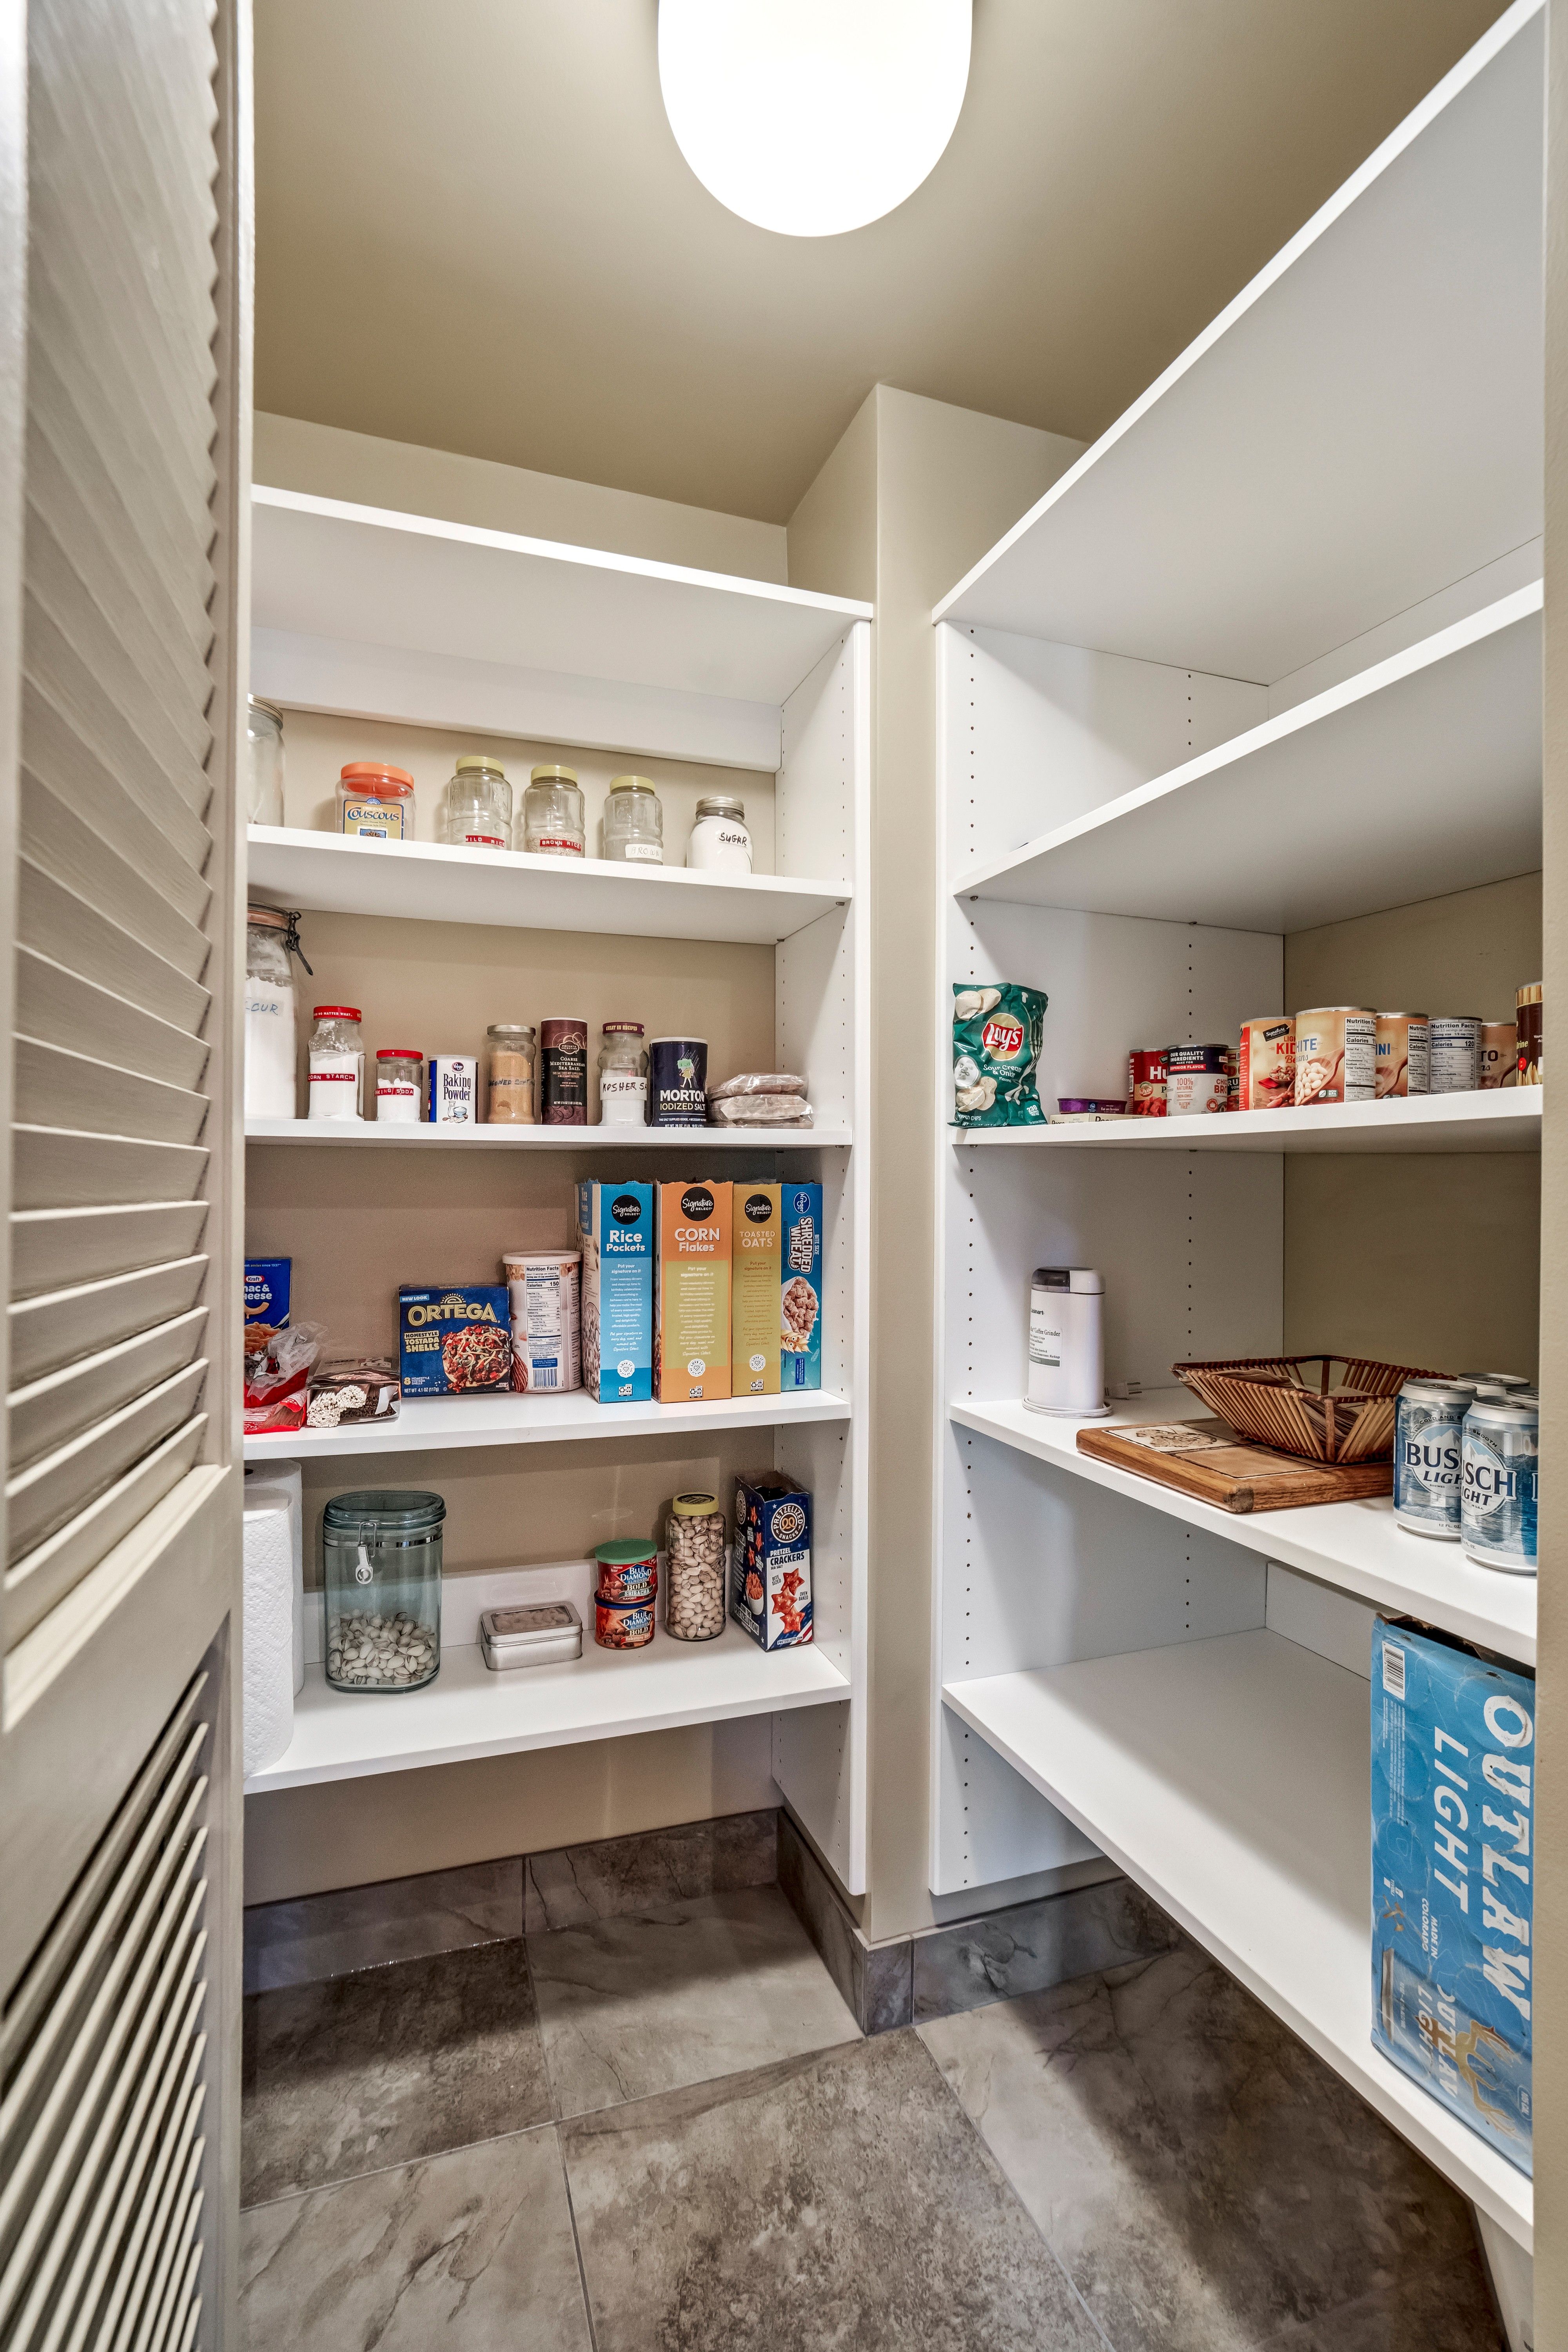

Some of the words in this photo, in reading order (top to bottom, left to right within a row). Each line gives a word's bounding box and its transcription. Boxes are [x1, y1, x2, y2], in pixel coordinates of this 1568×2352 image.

[347, 807, 399, 820] Couscous
[719, 832, 747, 846] SUGAR
[630, 847, 659, 856] BROWN
[985, 1024, 1021, 1051] Lay's
[1266, 1027, 1285, 1037] Signature
[1296, 1038, 1317, 1053] HITE
[1002, 1065, 1022, 1073] Cream
[443, 1073, 471, 1090] Baking
[603, 1082, 637, 1093] KOSHER
[443, 1086, 471, 1100] Powder
[660, 1090, 704, 1102] MORTON
[682, 1198, 713, 1212] Signature
[746, 1204, 771, 1215] Signature
[797, 1194, 807, 1212] Kroger
[613, 1205, 641, 1217] Signature
[610, 1230, 642, 1243] Rice
[675, 1228, 720, 1241] CORN
[606, 1243, 645, 1252] Pockets
[679, 1242, 715, 1252] Flakes
[742, 1238, 773, 1248] OATS
[790, 1226, 802, 1269] WHEAT
[800, 1217, 813, 1273] SHREDDED
[408, 1303, 497, 1326] ORTEGA
[406, 1343, 440, 1352] SHELLS
[1419, 1416, 1437, 1425] COLD
[1472, 1429, 1497, 1448] SMOOTH
[1406, 1441, 1461, 1470] BUS
[1423, 1471, 1461, 1485] LIGH
[1462, 1459, 1514, 1497] SCH
[1462, 1488, 1492, 1506] IGHT
[773, 1506, 802, 1529] PRETZELIZED
[779, 1530, 799, 1539] SNACKS
[770, 1548, 791, 1557] PRETZEL
[770, 1552, 804, 1566] CRACKERS
[621, 1568, 652, 1581] DIAMOND
[627, 1582, 647, 1590] BOLD
[623, 1613, 652, 1626] DIAMOND
[633, 1611, 647, 1620] BLUE
[630, 1627, 648, 1636] BOLD
[778, 1636, 803, 1644] PRETZELIZED.COM
[1434, 1726, 1468, 1914] LIGHT
[1482, 1695, 1533, 2021] OUTLAW
[1431, 1945, 1438, 1959] IN
